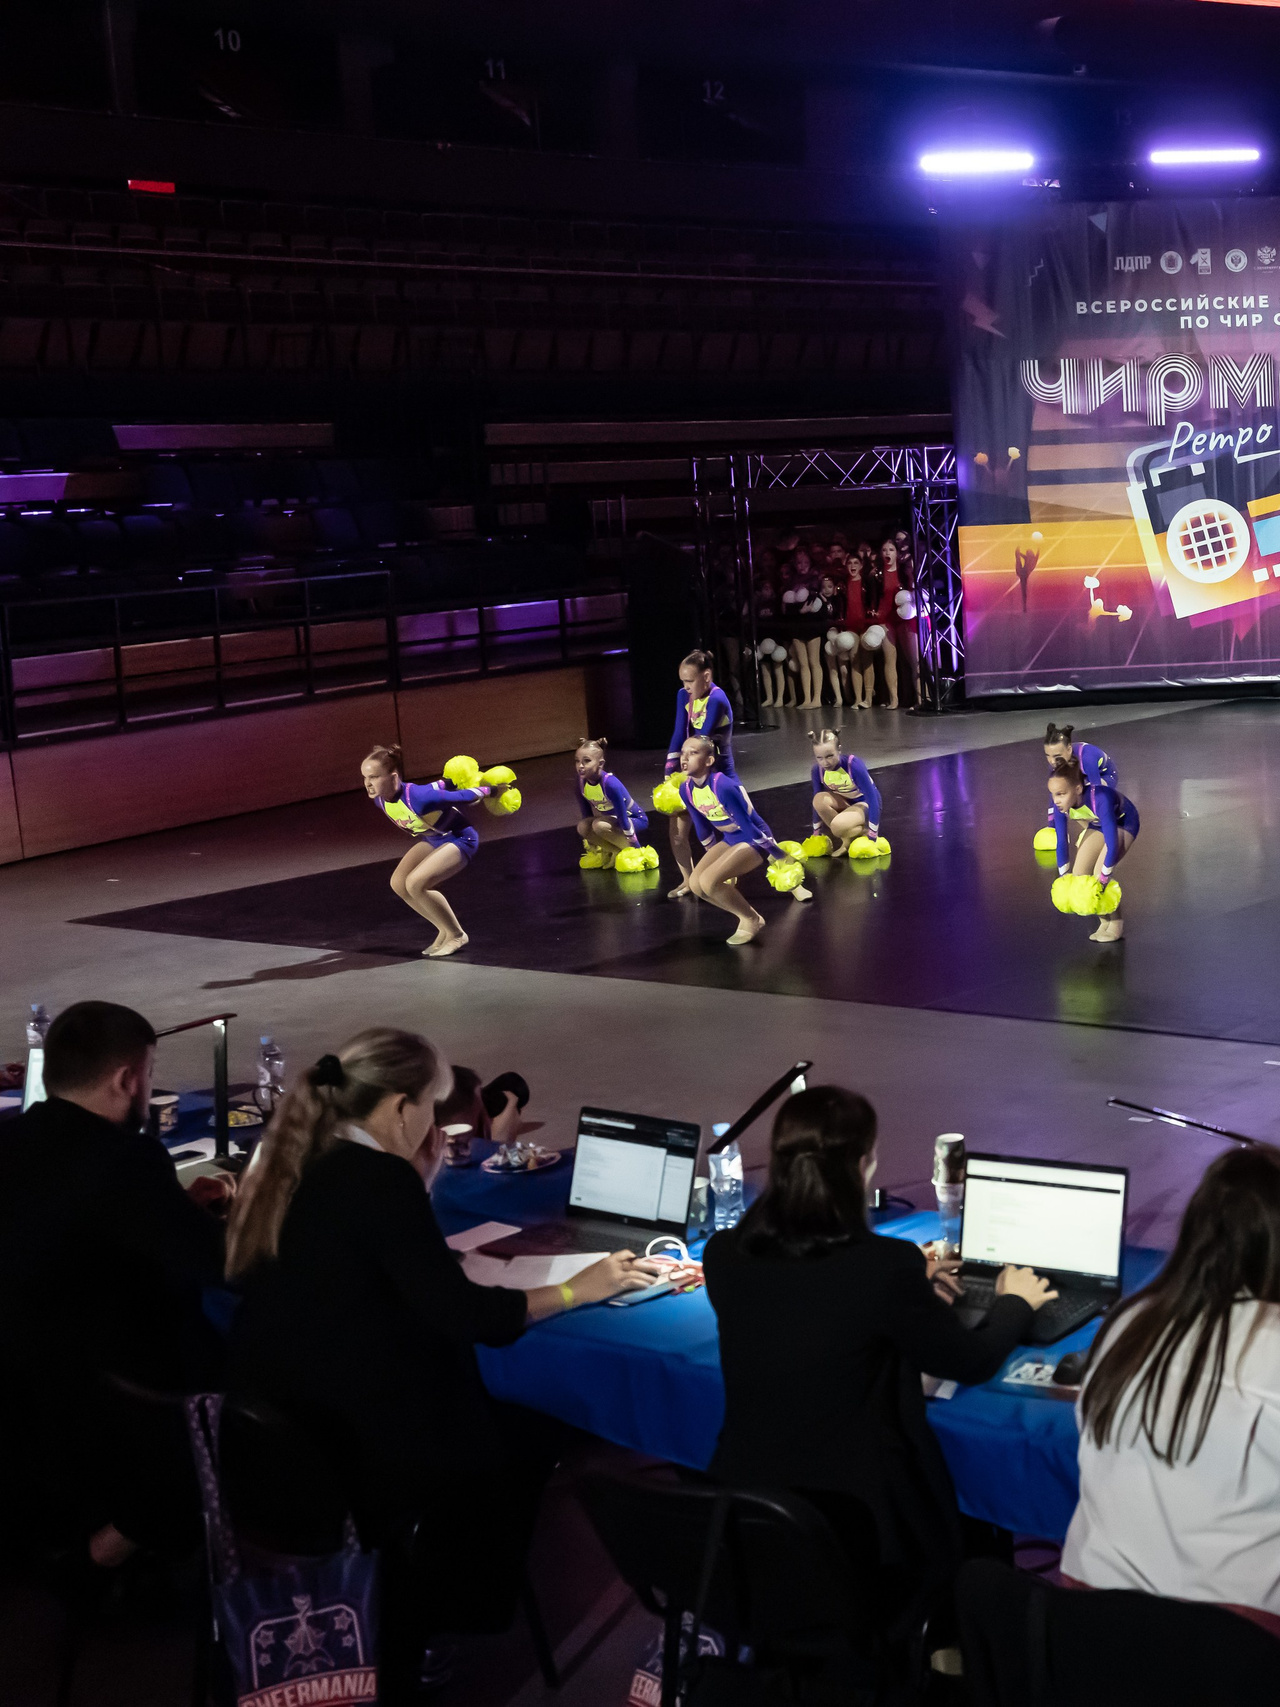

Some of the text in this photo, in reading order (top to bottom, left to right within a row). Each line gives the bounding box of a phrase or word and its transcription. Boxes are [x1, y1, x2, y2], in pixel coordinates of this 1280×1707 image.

[214, 28, 242, 53] 10
[484, 57, 508, 80] 11
[702, 80, 725, 102] 12
[1114, 255, 1152, 273] ЛДПР
[1076, 294, 1270, 315] ВСЕРОССИЙСКИЕ
[1180, 315, 1210, 330] ПО
[1219, 313, 1263, 328] ЧИР
[1168, 421, 1274, 463] Ретро
